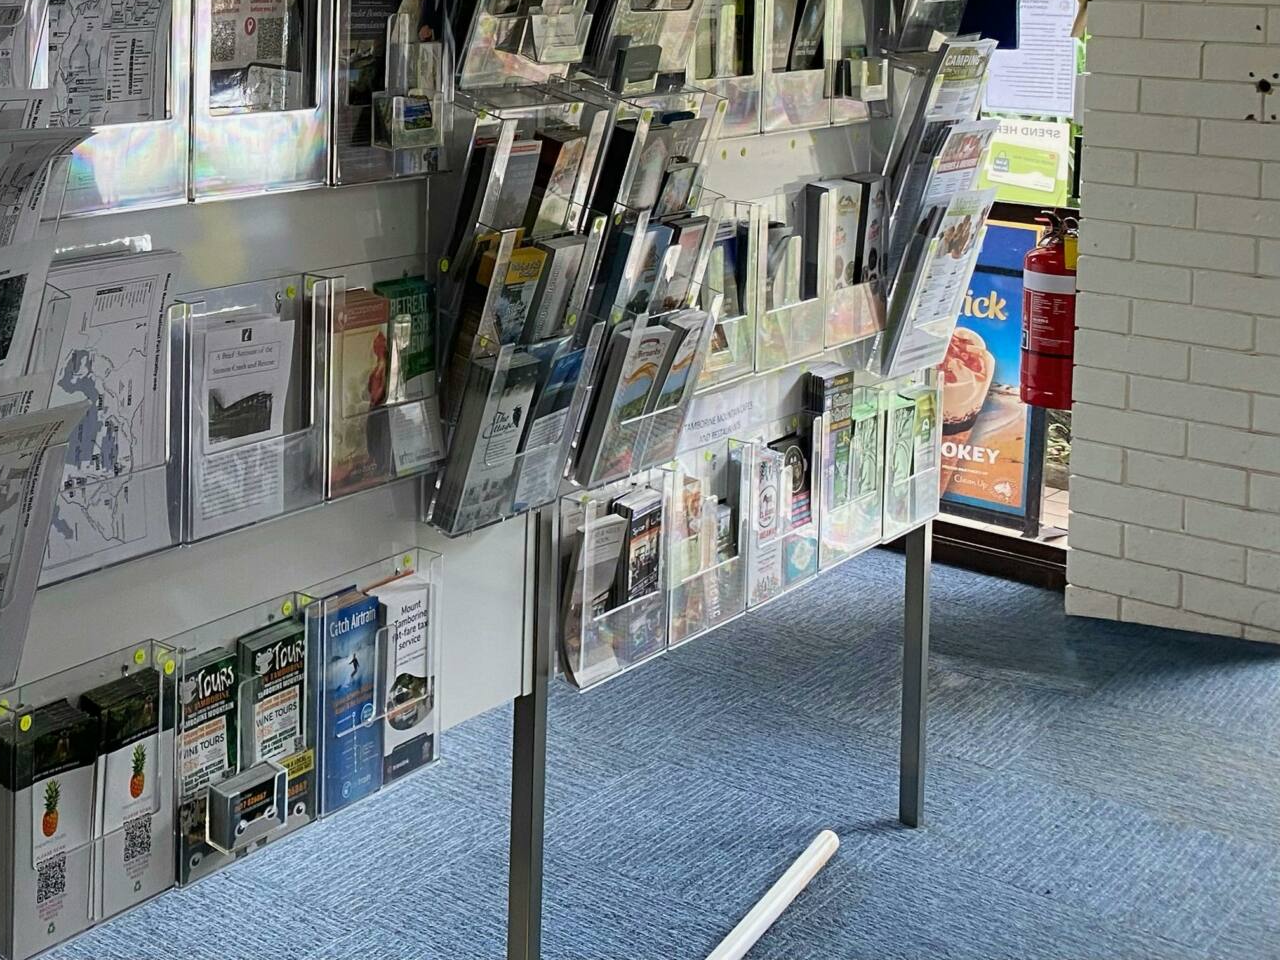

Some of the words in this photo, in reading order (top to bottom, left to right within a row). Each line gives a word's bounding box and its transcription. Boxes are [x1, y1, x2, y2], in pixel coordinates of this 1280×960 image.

[944, 54, 980, 66] CAMPING
[390, 293, 428, 315] RETREAT
[963, 289, 1007, 321] ick
[495, 411, 509, 424] The
[940, 441, 1000, 465] OKEY
[953, 473, 976, 487] Clean
[976, 478, 989, 490] Up
[401, 600, 422, 616] Mount
[329, 617, 350, 638] Catch
[350, 607, 376, 630] Airtrain
[393, 608, 428, 629] Tamborine
[417, 619, 429, 629] tax
[398, 633, 422, 651] service
[197, 665, 235, 700] TOURS
[255, 709, 273, 729] WINE
[272, 701, 297, 721] TOURS
[200, 732, 225, 751] TOURS
